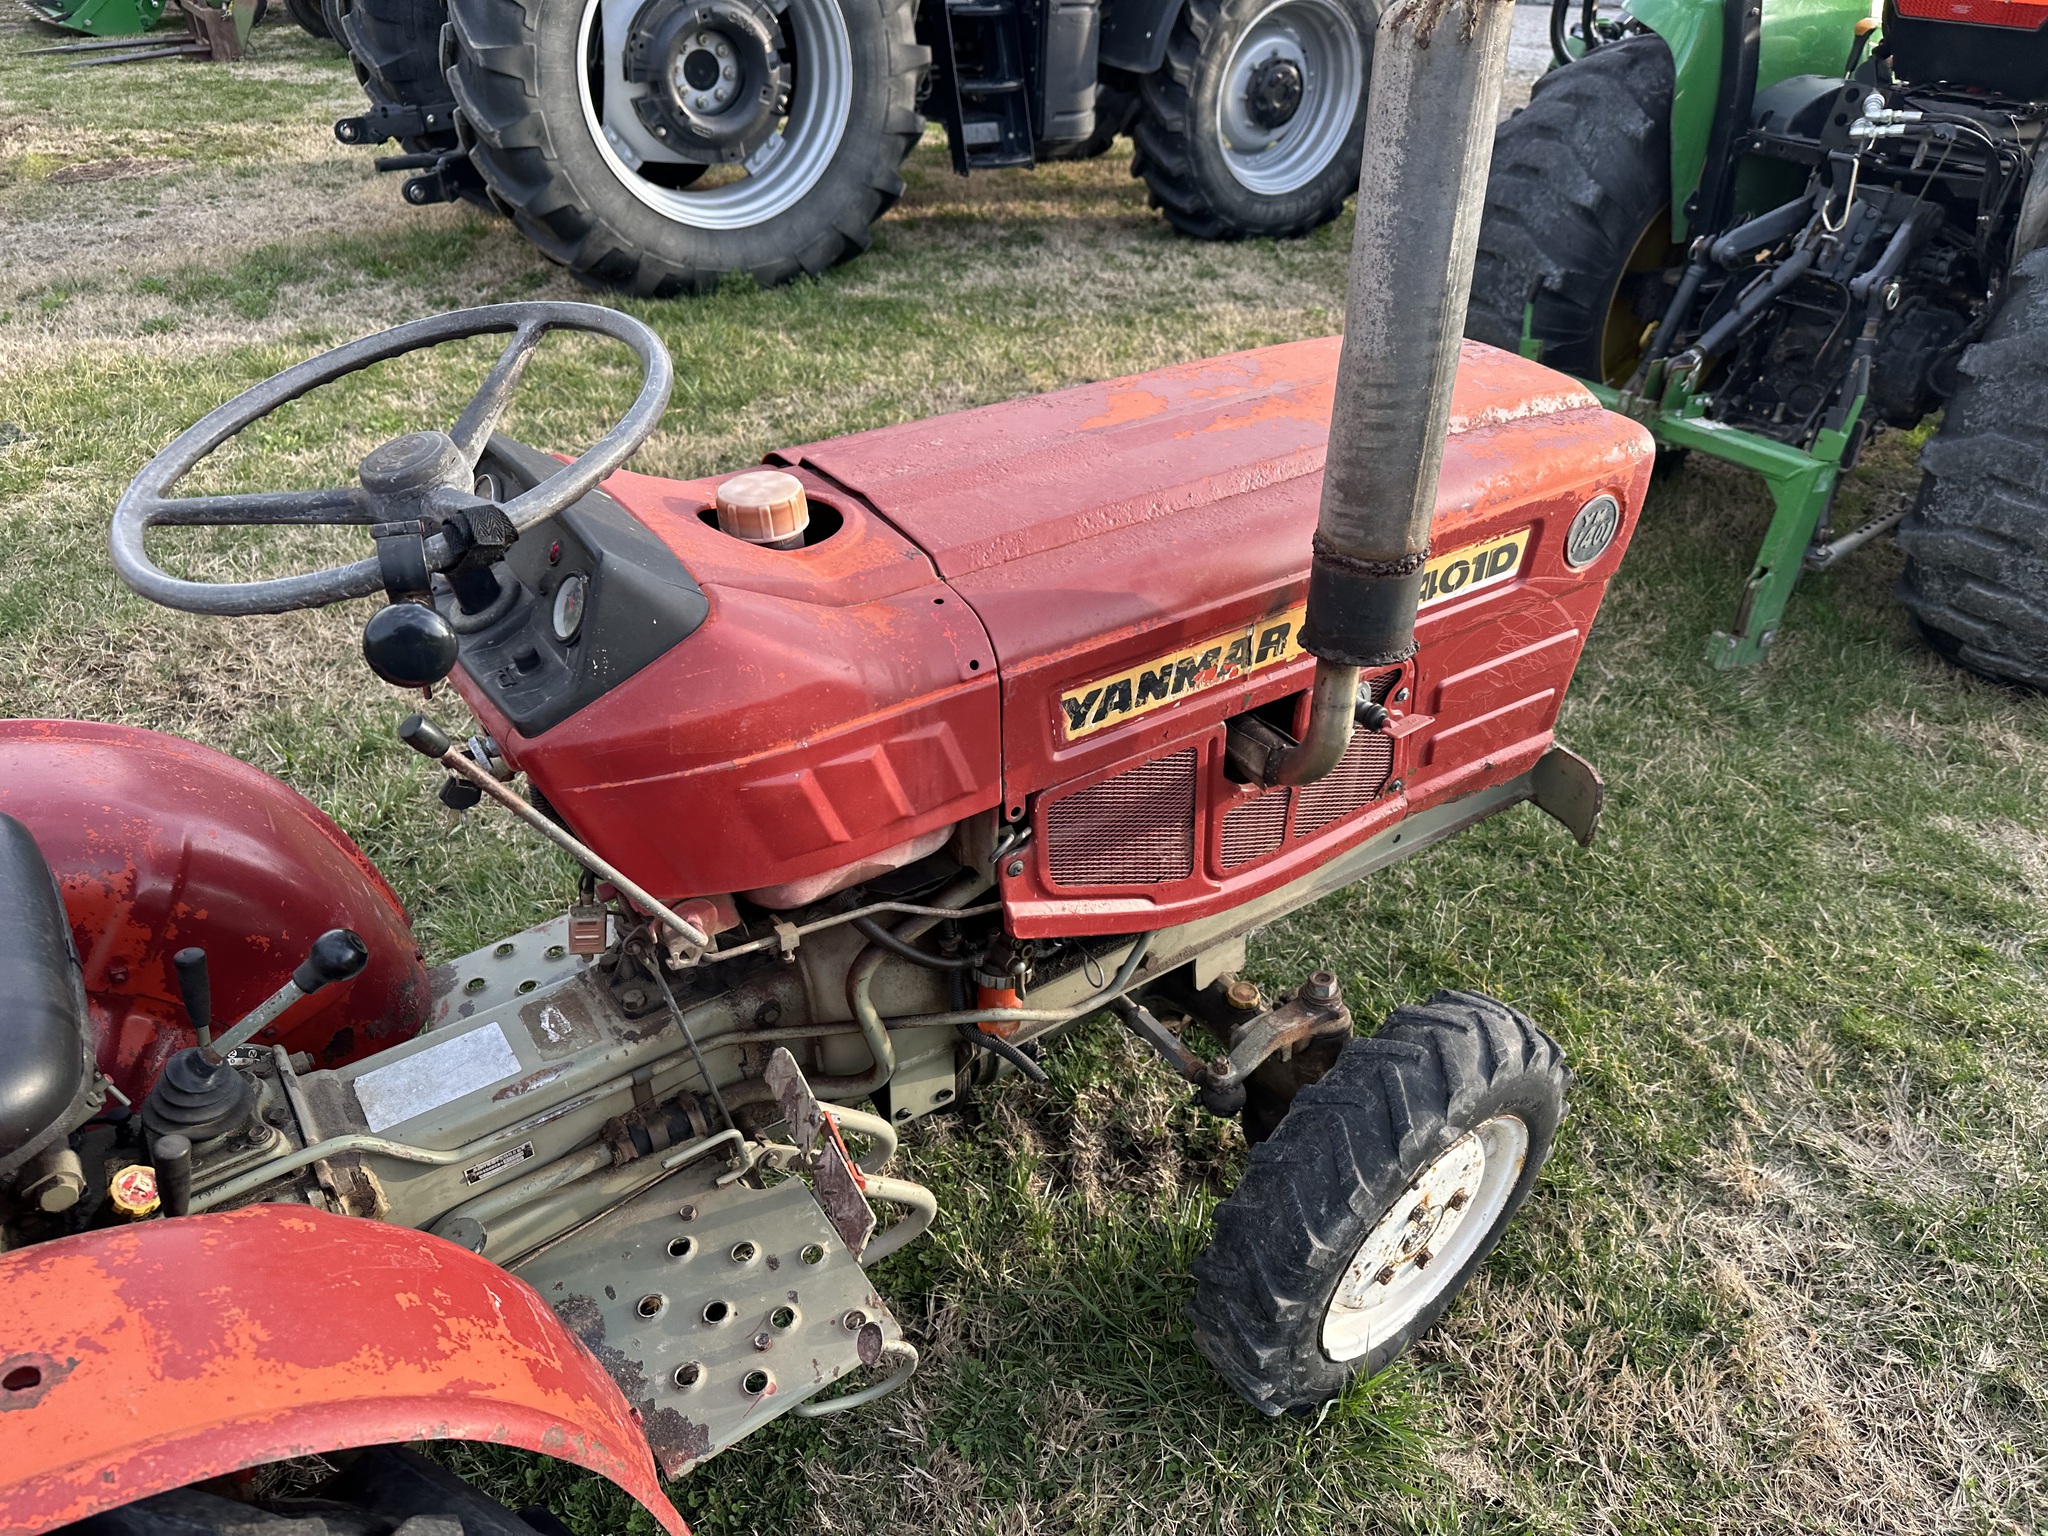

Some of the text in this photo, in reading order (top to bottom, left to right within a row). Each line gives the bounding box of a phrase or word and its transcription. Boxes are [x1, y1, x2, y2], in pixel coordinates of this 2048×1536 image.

[1582, 507, 1608, 528] YM
[1571, 519, 1613, 554] 1401
[1062, 622, 1291, 731] YANMAR
